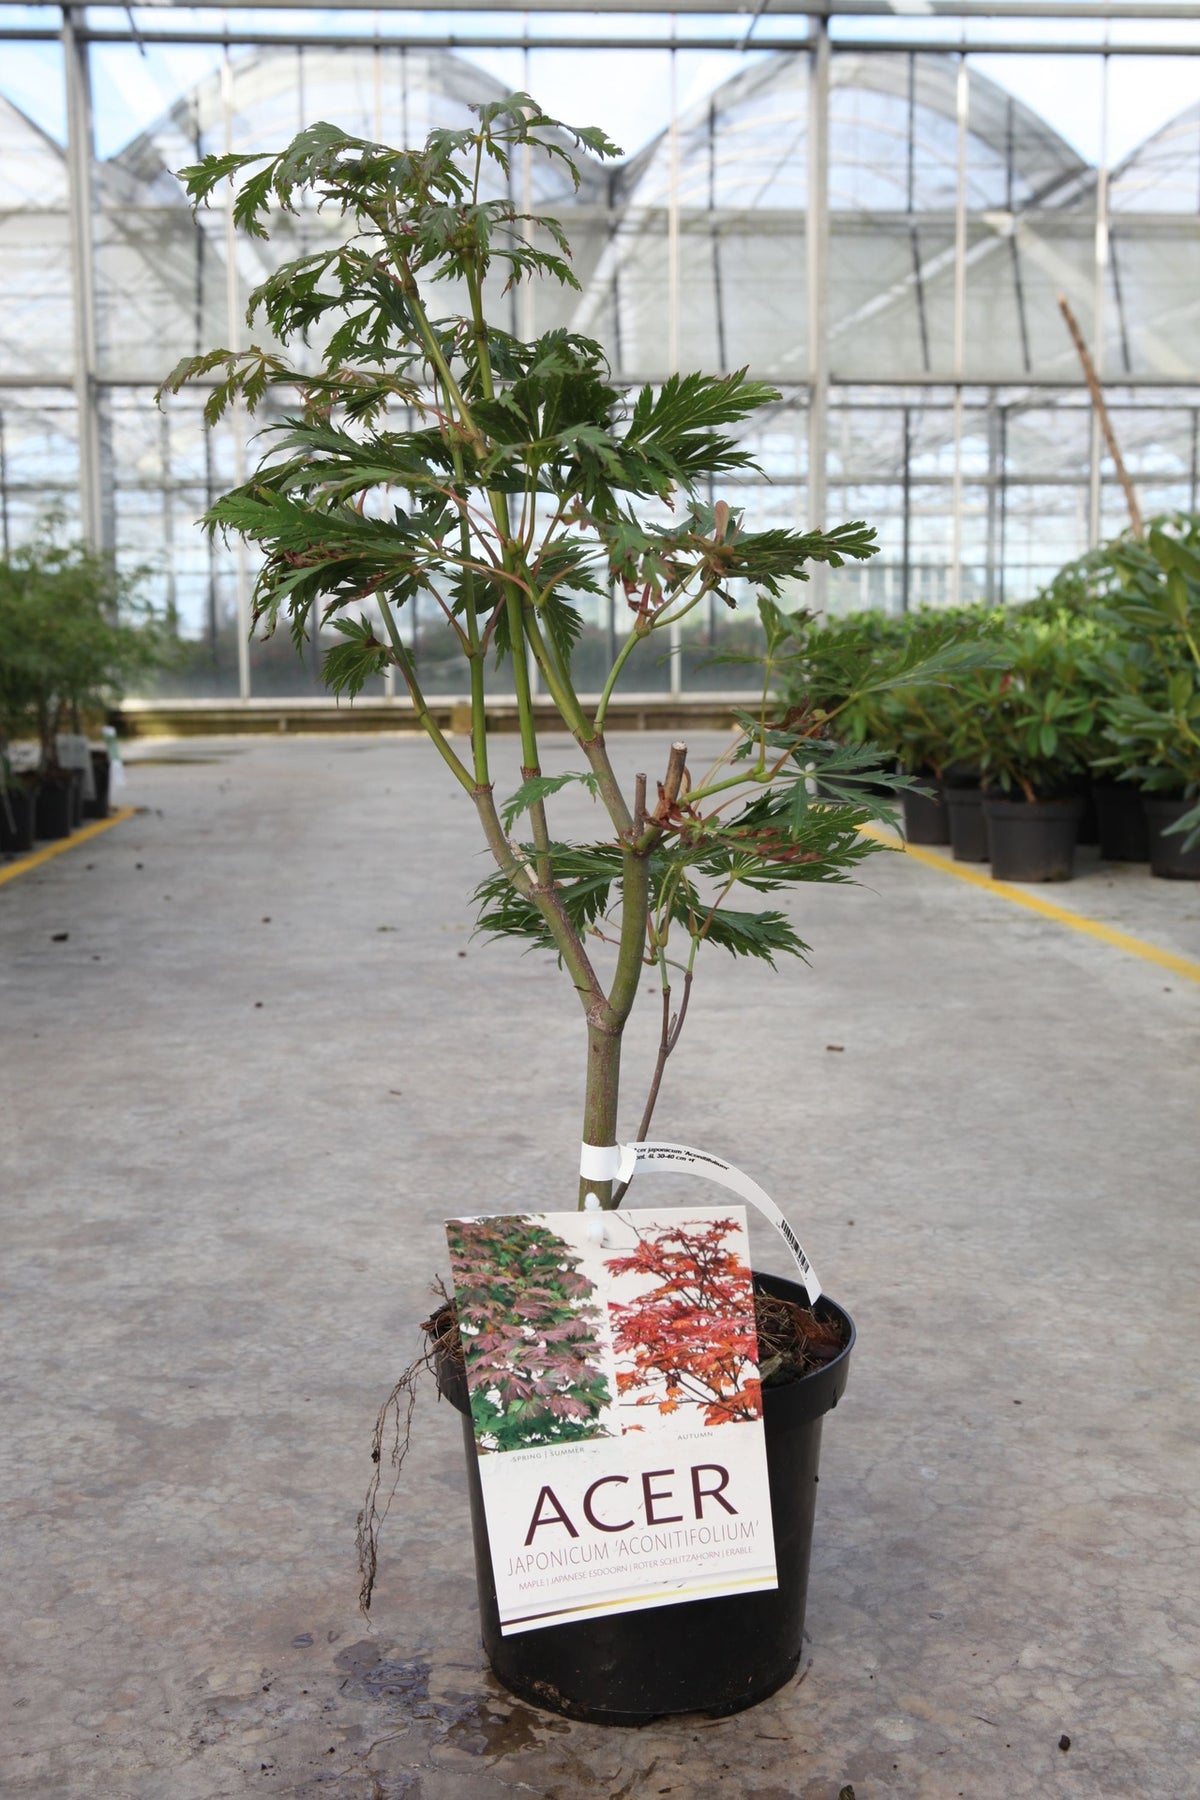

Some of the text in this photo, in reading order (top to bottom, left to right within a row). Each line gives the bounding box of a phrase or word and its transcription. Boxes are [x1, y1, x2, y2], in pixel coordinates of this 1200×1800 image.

[511, 1447, 585, 1463] SPRING SUMMER
[677, 1431, 714, 1441] AUTUMN
[524, 1464, 739, 1546] ACER
[508, 1520, 760, 1577] JAPONICUM 'ACONITIFOLIUM'
[519, 1578, 545, 1591] MAPLE
[550, 1571, 588, 1585] JAPANESE
[588, 1565, 628, 1578] ESDOORN
[633, 1560, 659, 1571] ROTER
[725, 1545, 753, 1557] ERABLE
